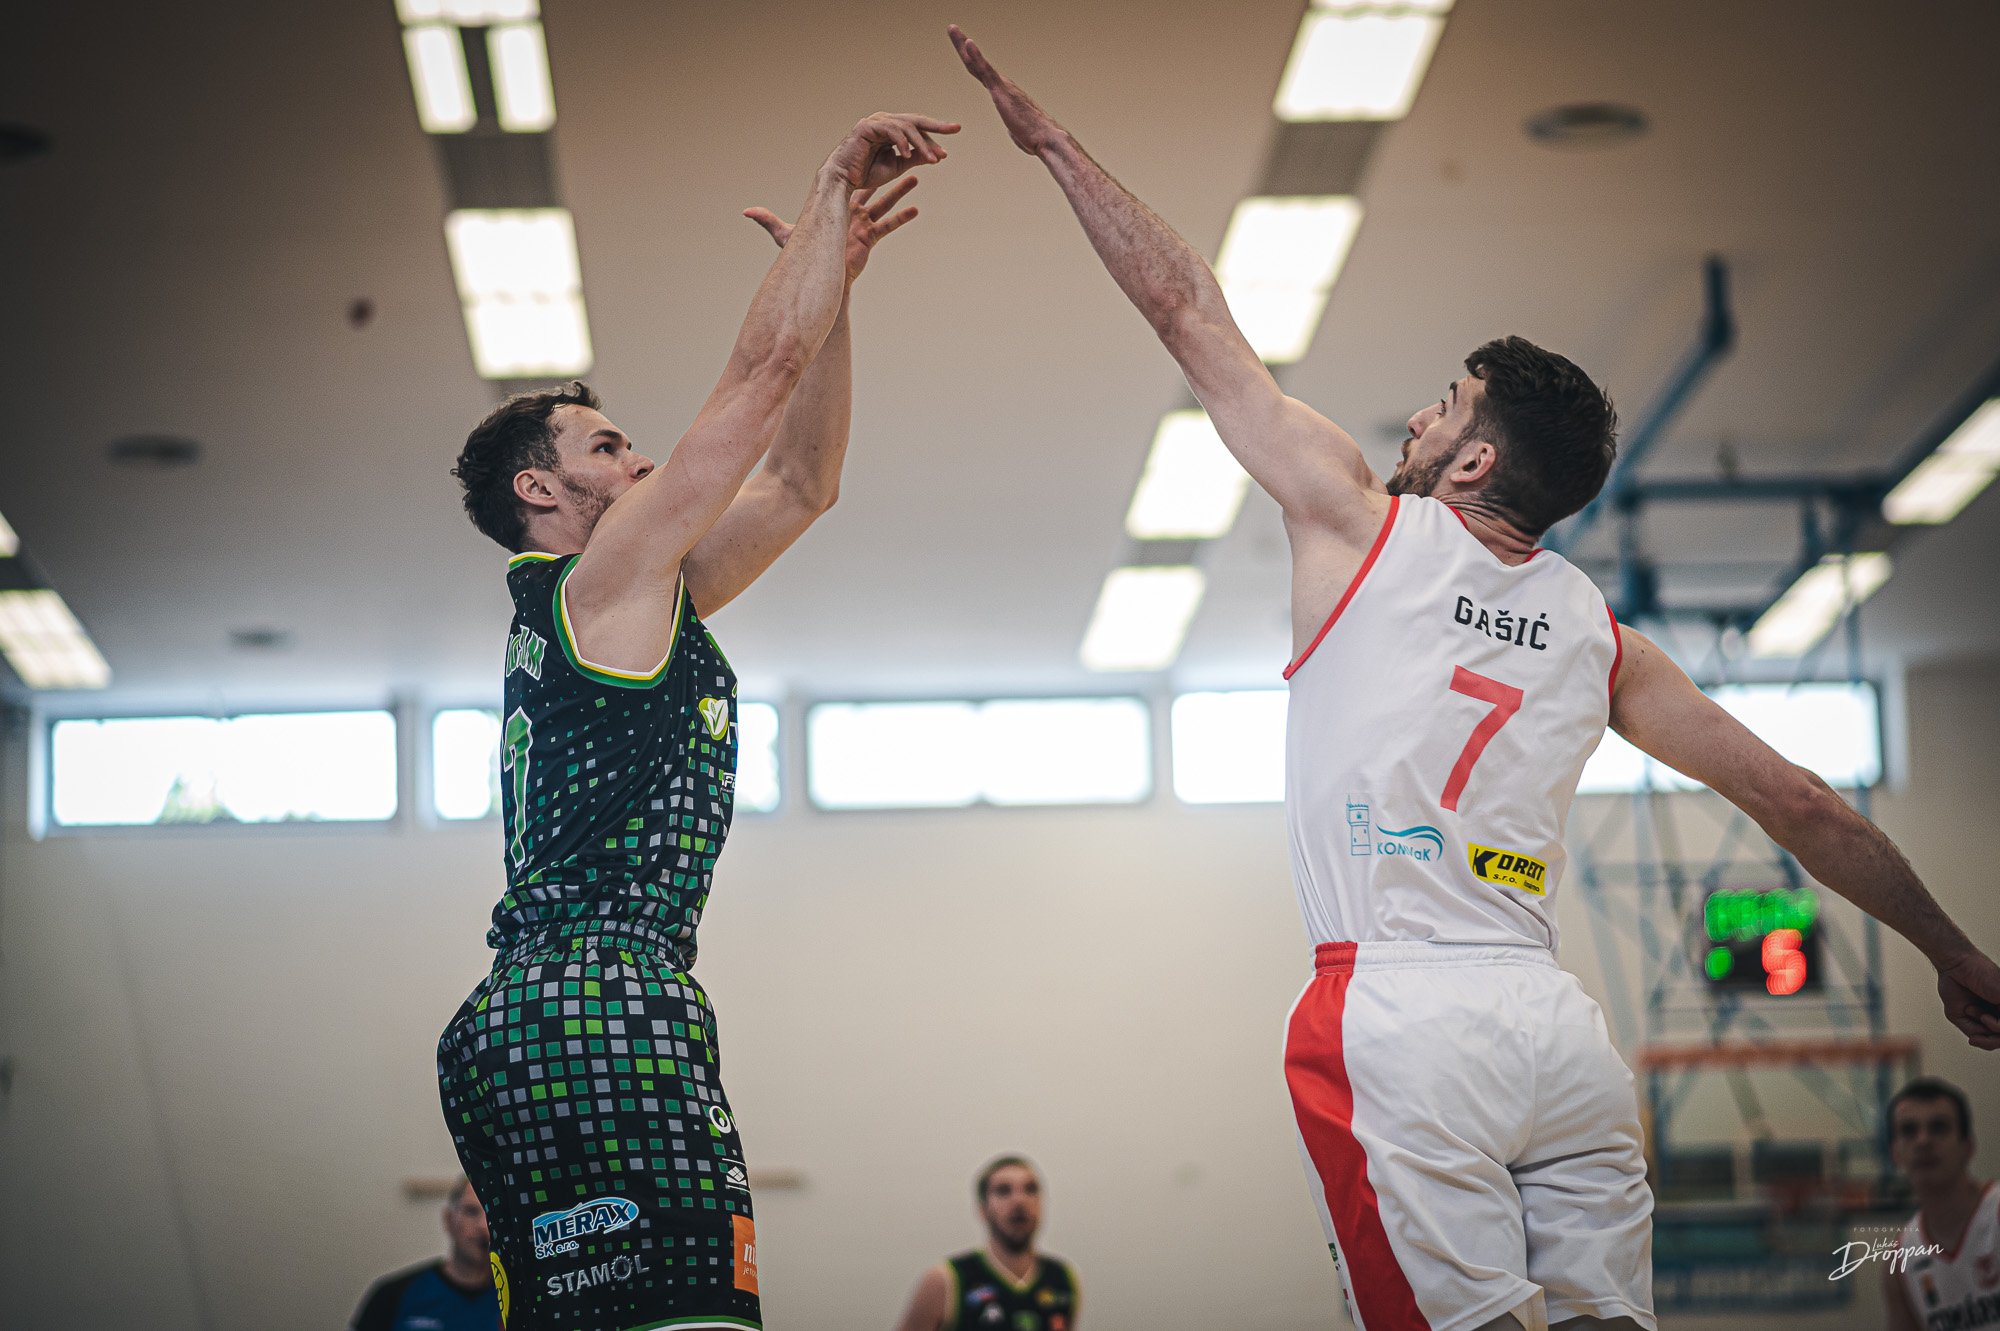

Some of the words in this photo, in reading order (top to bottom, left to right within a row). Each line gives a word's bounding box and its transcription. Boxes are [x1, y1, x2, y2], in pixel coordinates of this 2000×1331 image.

[1454, 595, 1550, 651] GAŠIĆ
[1440, 664, 1524, 812] 7
[1493, 873, 1518, 884] s.r.o.
[533, 1203, 632, 1247] MERAX
[555, 1240, 580, 1254] s.r.o.
[547, 1254, 650, 1296] STAMOL
